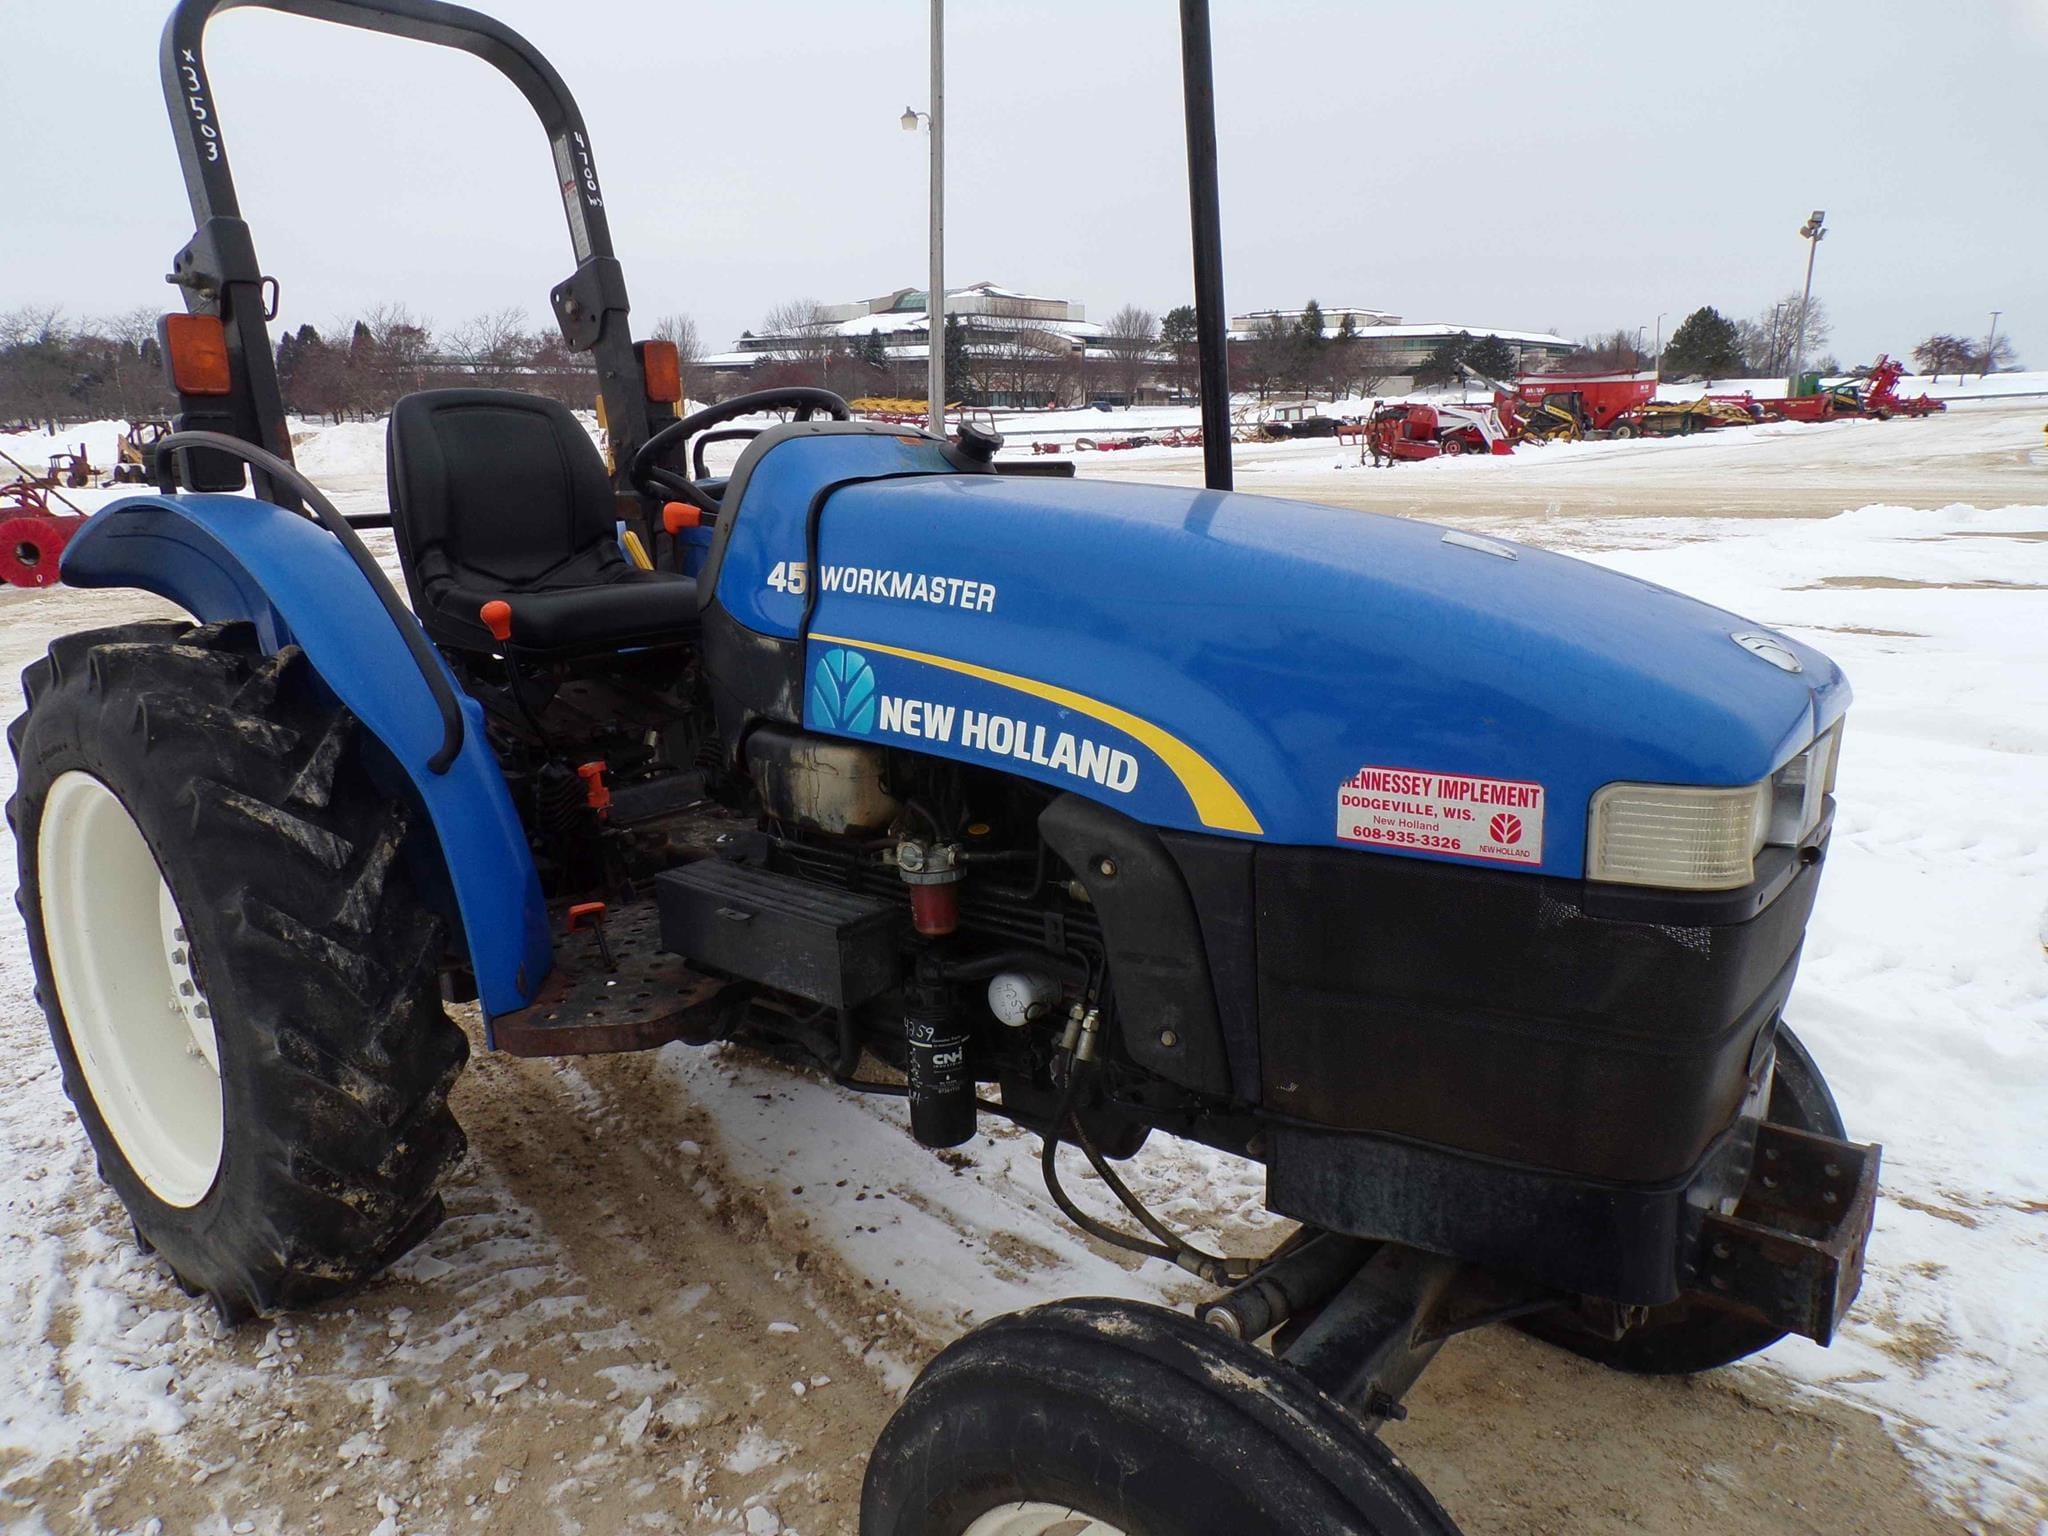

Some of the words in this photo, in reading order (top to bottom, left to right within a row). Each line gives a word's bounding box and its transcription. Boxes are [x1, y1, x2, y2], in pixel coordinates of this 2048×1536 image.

[766, 561, 808, 594] 45
[820, 565, 997, 613] WORKMASTER
[879, 695, 955, 742] NEW
[961, 709, 1140, 794] HOLLAND
[1437, 779, 1540, 809] IMPLEMENT
[1341, 795, 1438, 819] DODGEVILLE,
[1443, 806, 1476, 822] WIS.
[1353, 825, 1461, 850] 608-935-3326
[1373, 815, 1396, 827] New
[1398, 818, 1440, 832] Holland
[1479, 845, 1495, 854] NEW
[1496, 847, 1530, 858] HOLLAND
